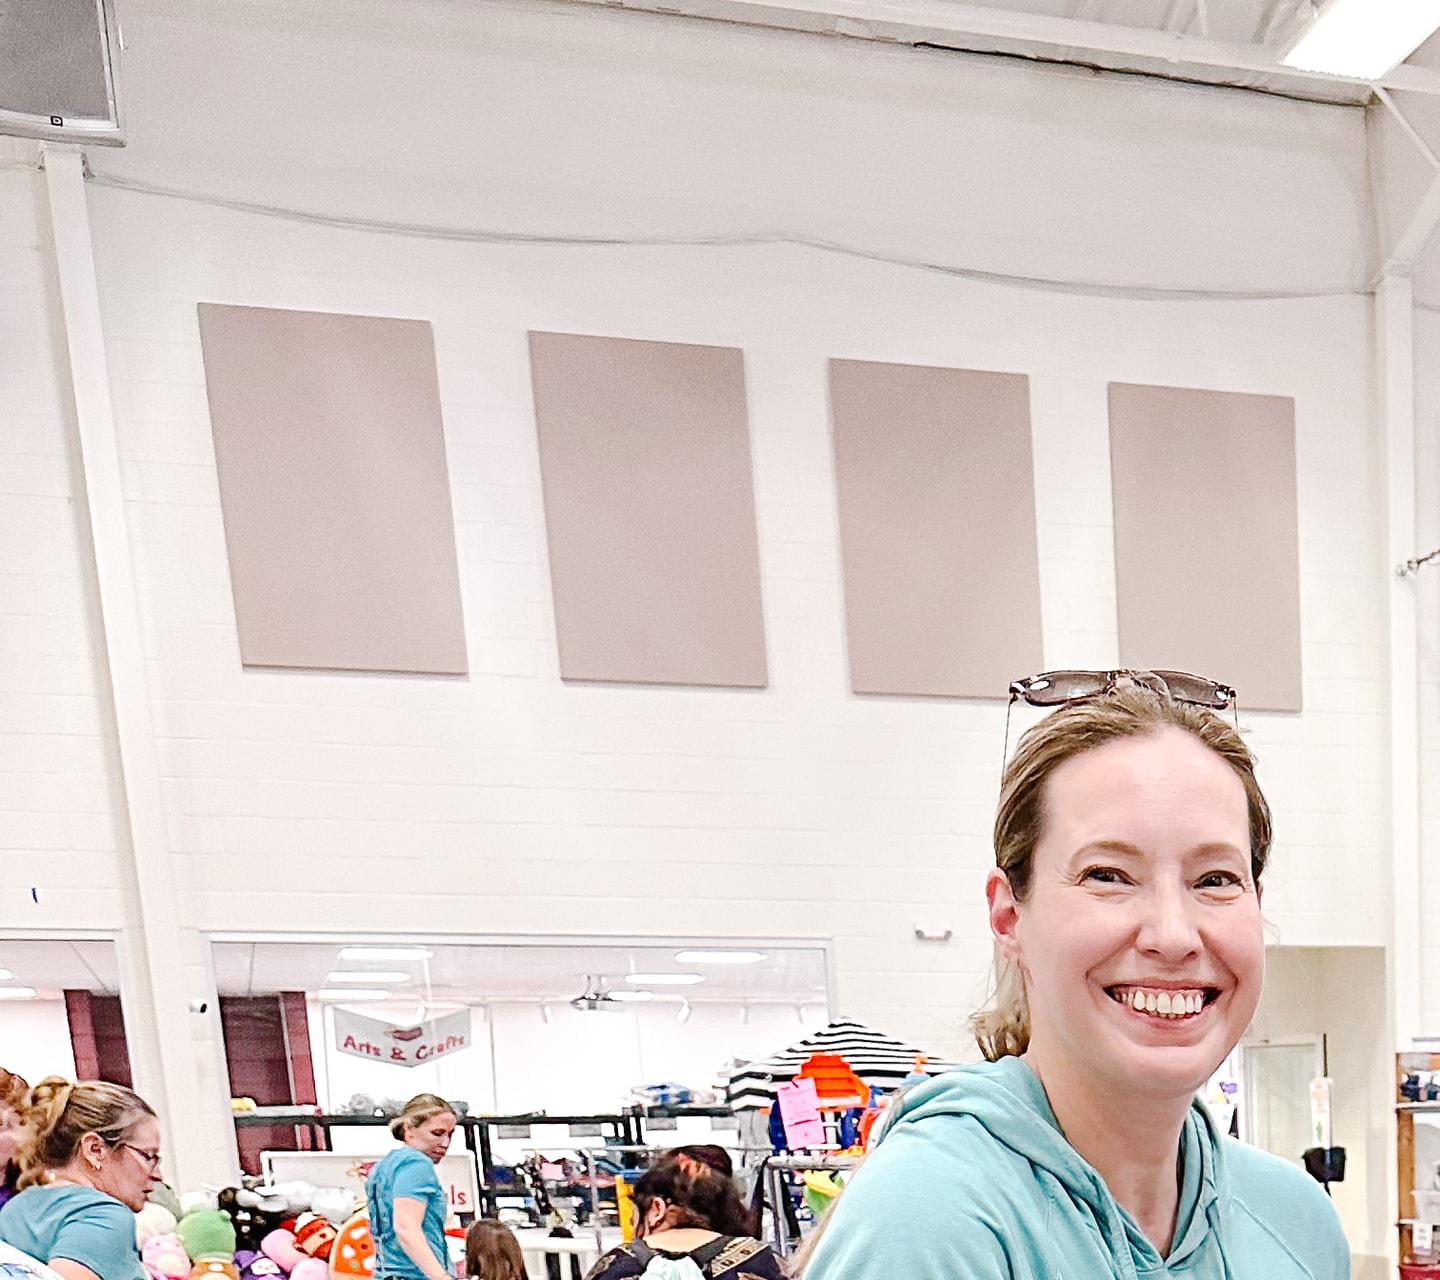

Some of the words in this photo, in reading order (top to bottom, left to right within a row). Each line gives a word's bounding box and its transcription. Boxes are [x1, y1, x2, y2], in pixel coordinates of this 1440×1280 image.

[344, 1035, 381, 1056] Arts
[390, 1047, 407, 1060] &
[415, 1035, 465, 1060] Crafts
